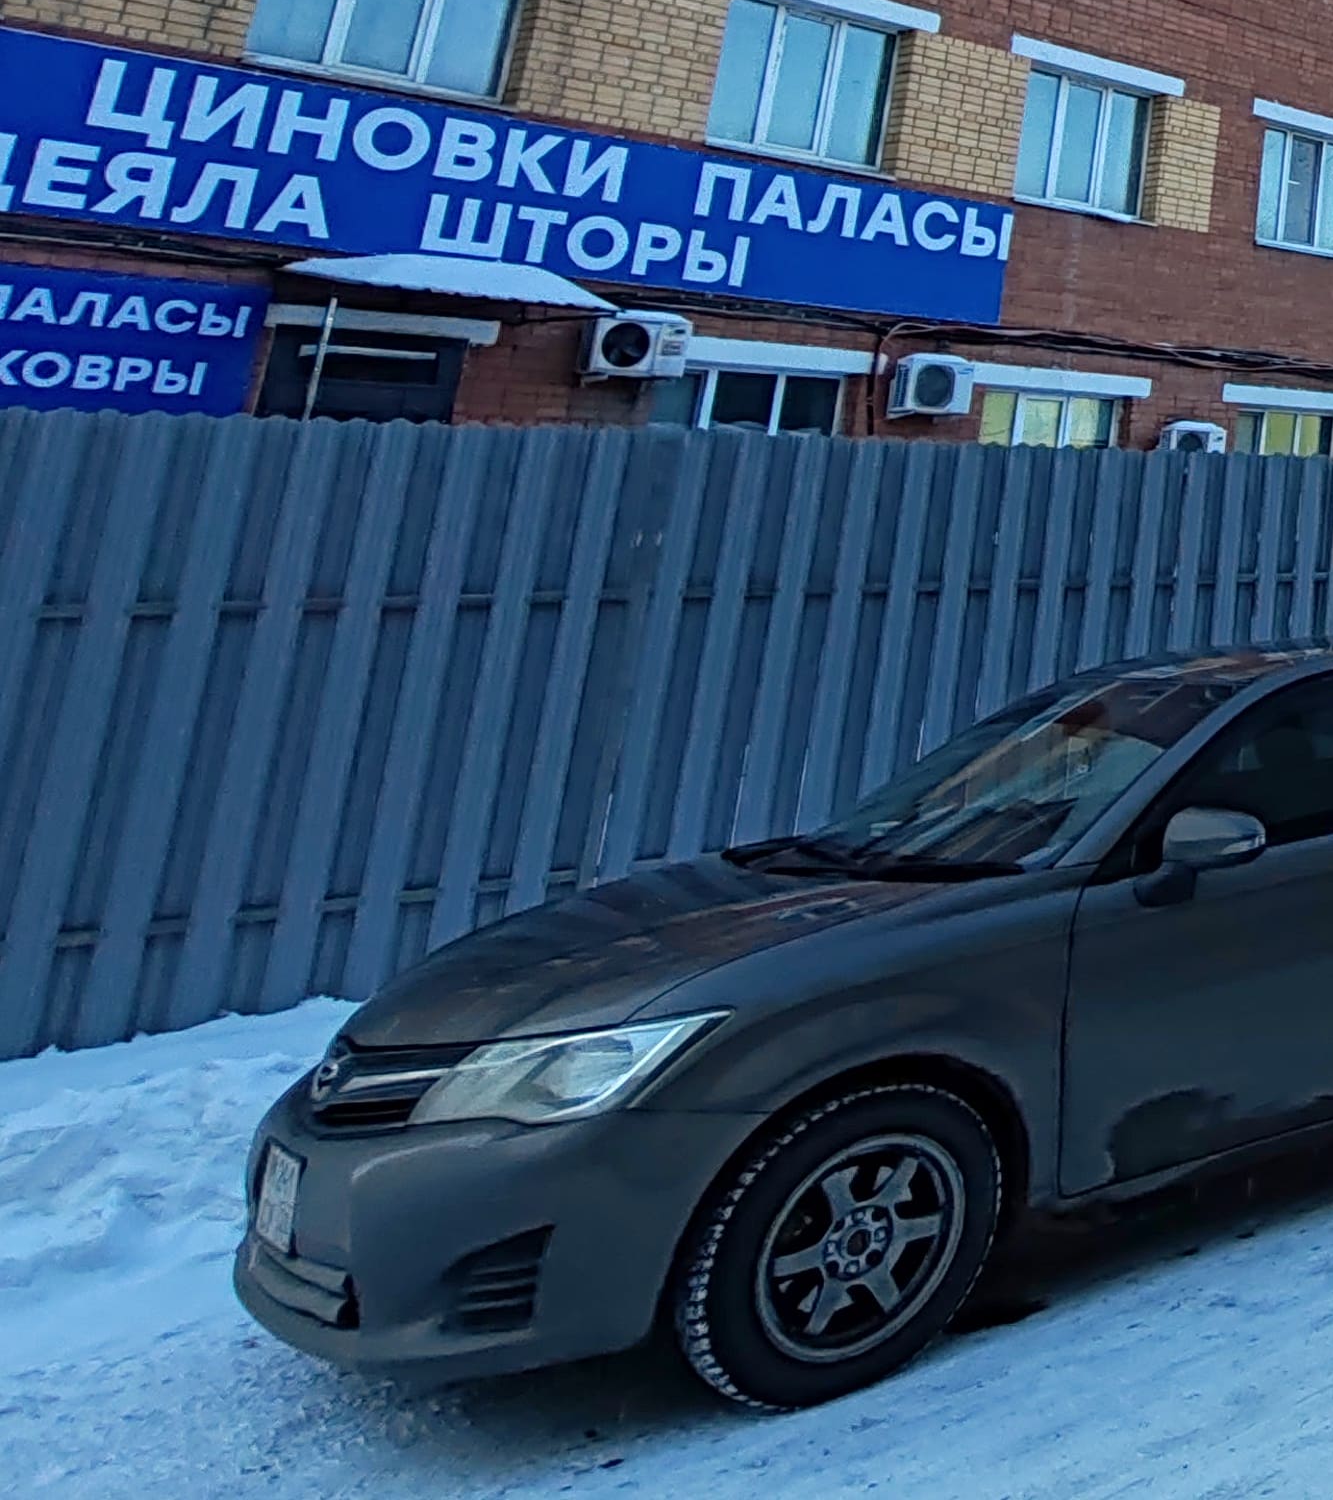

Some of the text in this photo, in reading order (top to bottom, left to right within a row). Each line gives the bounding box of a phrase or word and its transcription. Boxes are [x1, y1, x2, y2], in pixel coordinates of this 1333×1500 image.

[0, 132, 750, 287] ЕЯЛА ШТОРЫ
[86, 58, 1014, 262] ЦИНОВКИ ПАЛАСЫ
